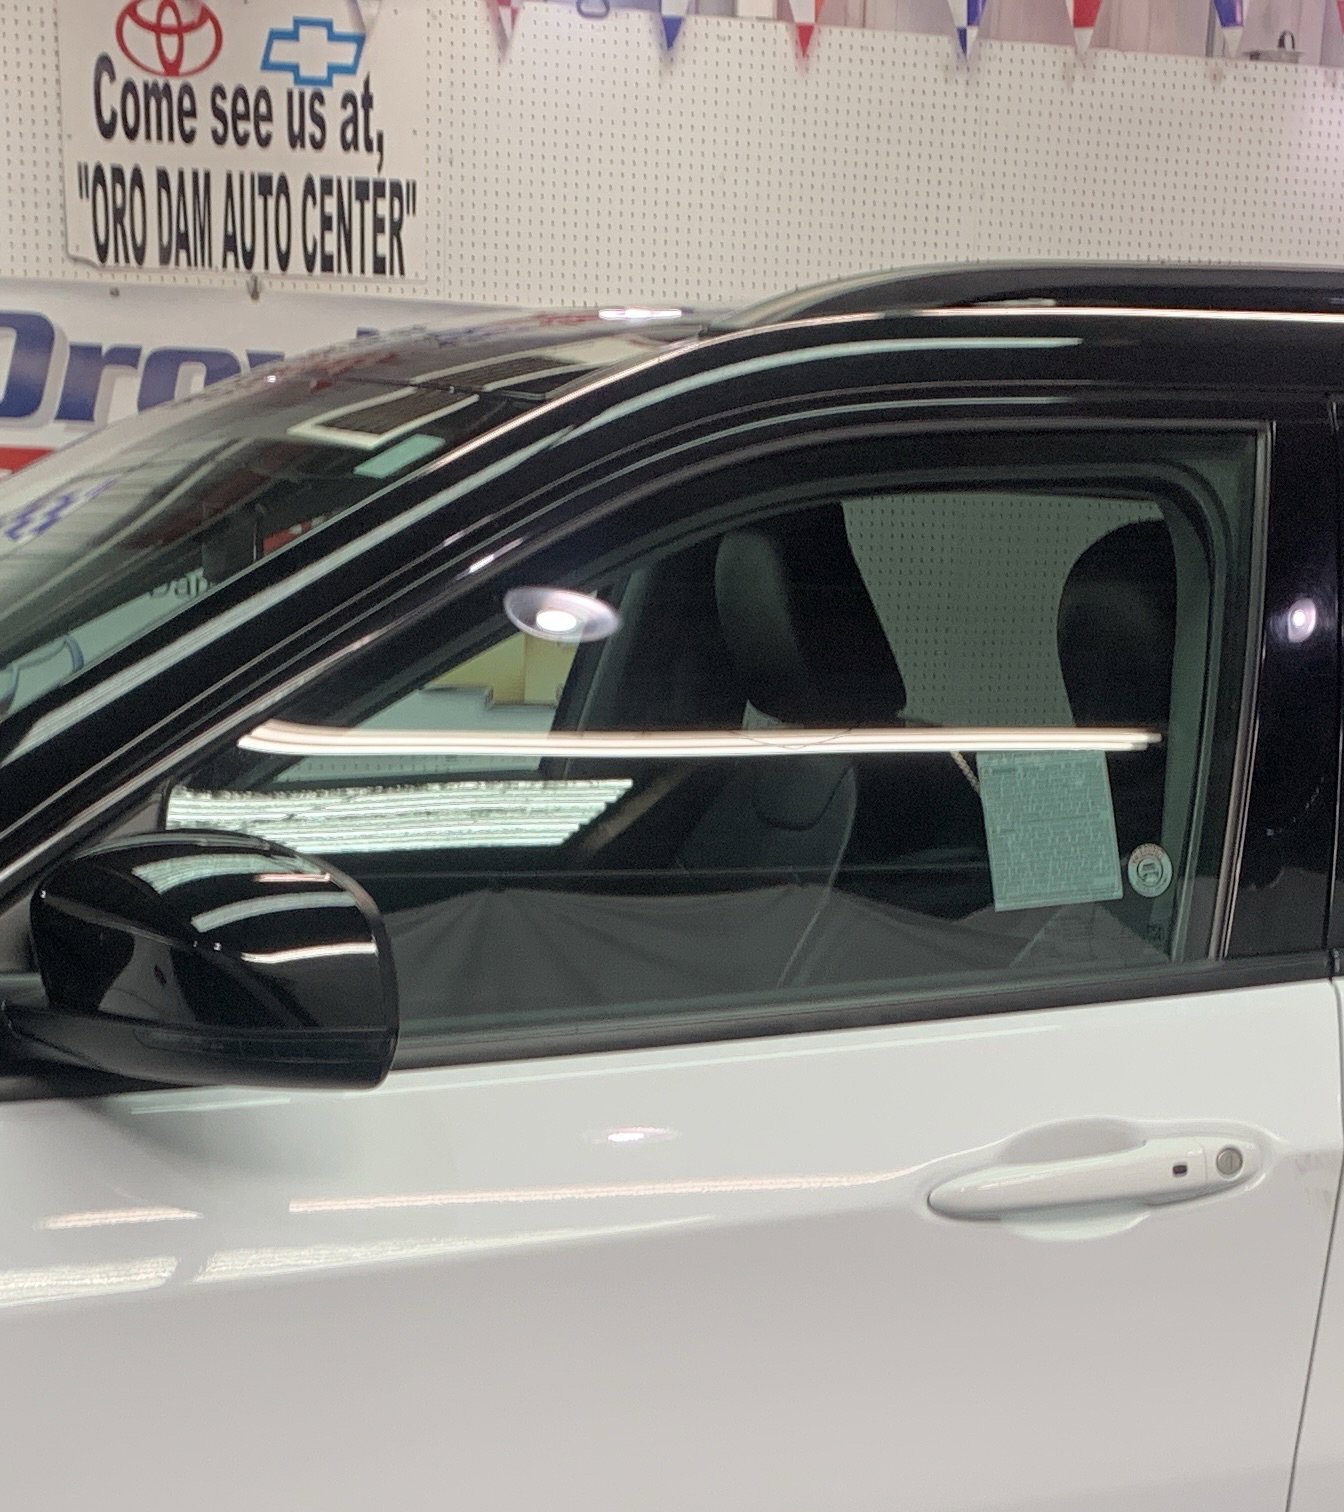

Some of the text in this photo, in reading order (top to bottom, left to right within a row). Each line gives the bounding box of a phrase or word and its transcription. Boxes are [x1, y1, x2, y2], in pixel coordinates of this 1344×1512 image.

[93, 52, 384, 172] Come see us at,
[77, 161, 416, 278] "ORO DAM AUTO CENTER"
